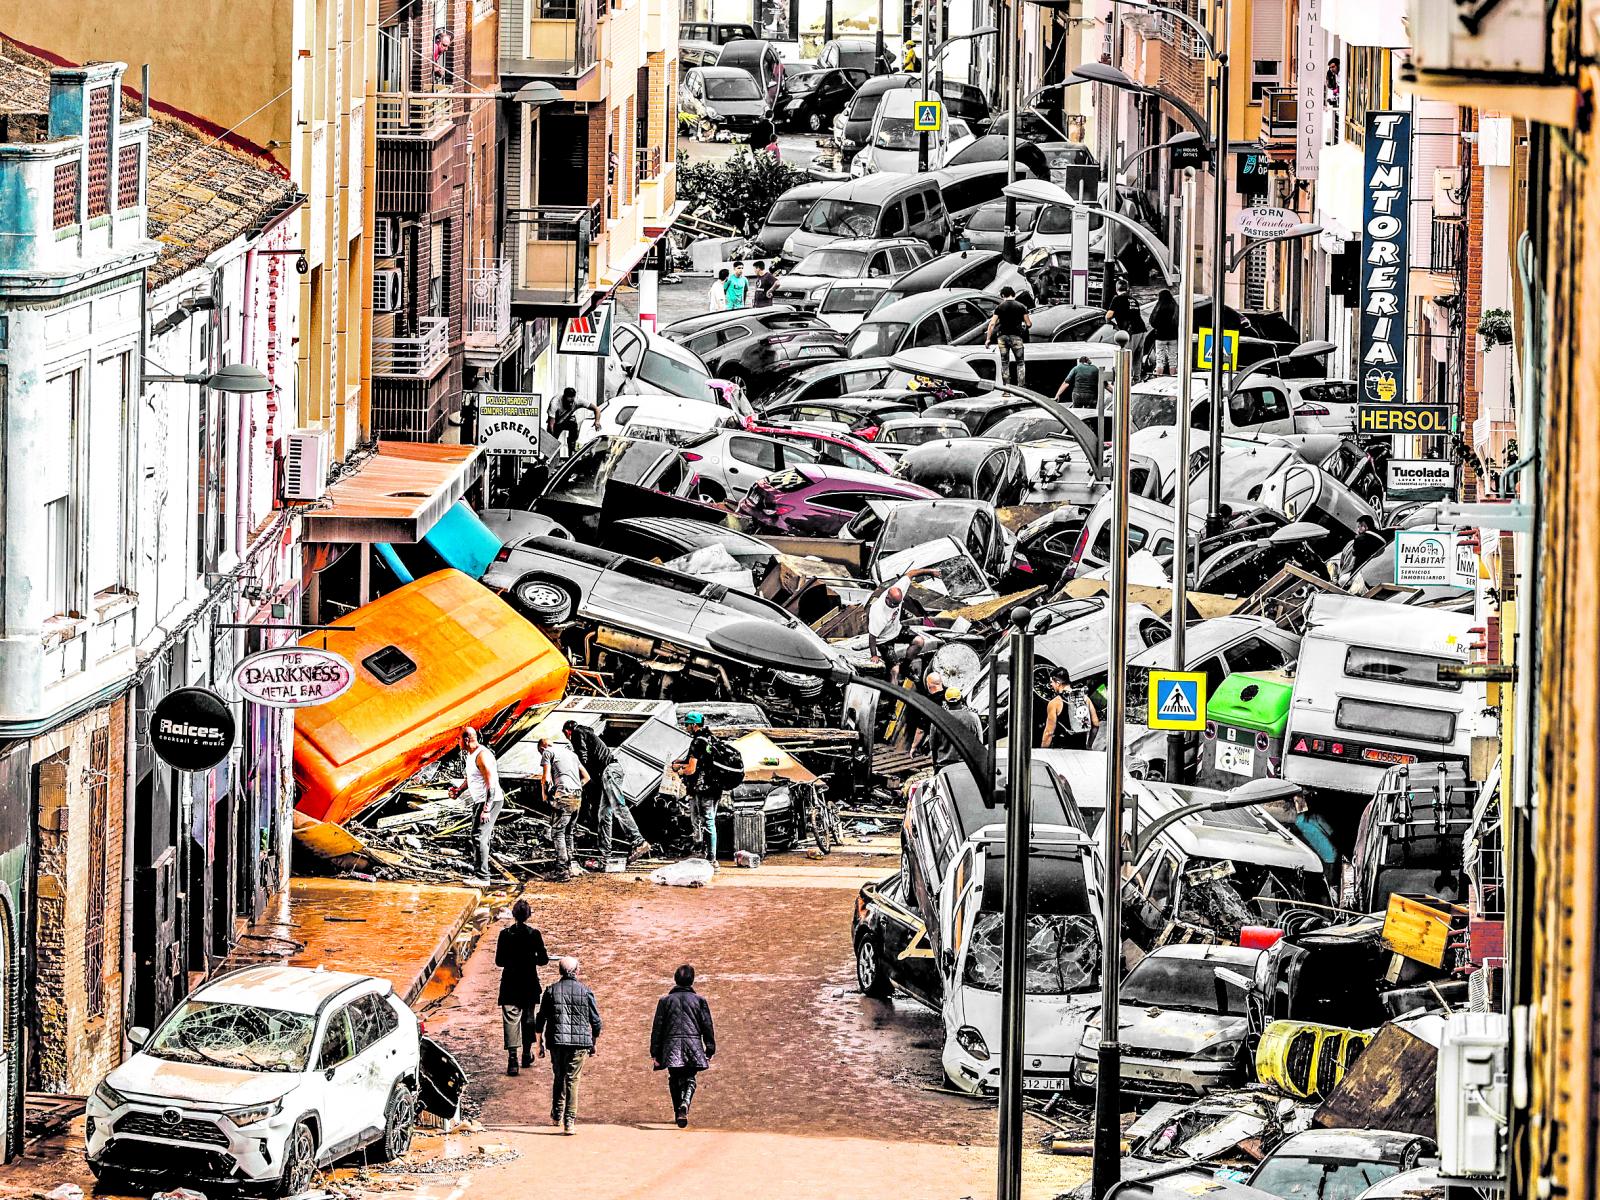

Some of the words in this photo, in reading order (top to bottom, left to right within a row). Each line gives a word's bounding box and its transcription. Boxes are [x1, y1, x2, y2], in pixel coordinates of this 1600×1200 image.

[1306, 0, 1317, 72] EMILIO
[1252, 209, 1284, 218] FORN
[1240, 215, 1252, 226] La
[1243, 226, 1288, 237] PASTISSERI
[1364, 115, 1403, 365] TINTORERIA
[567, 334, 596, 343] FIATC
[486, 396, 507, 406] POLLOS
[1361, 410, 1447, 431] HERSOL
[480, 421, 538, 446] GUERRERO
[1391, 466, 1450, 478] Tucolada
[1401, 543, 1427, 554] INMO
[282, 653, 303, 665] PUB
[245, 662, 341, 684] DARKNESS
[261, 685, 297, 698] METAL
[300, 684, 324, 697] BAR
[160, 718, 219, 739] Raices
